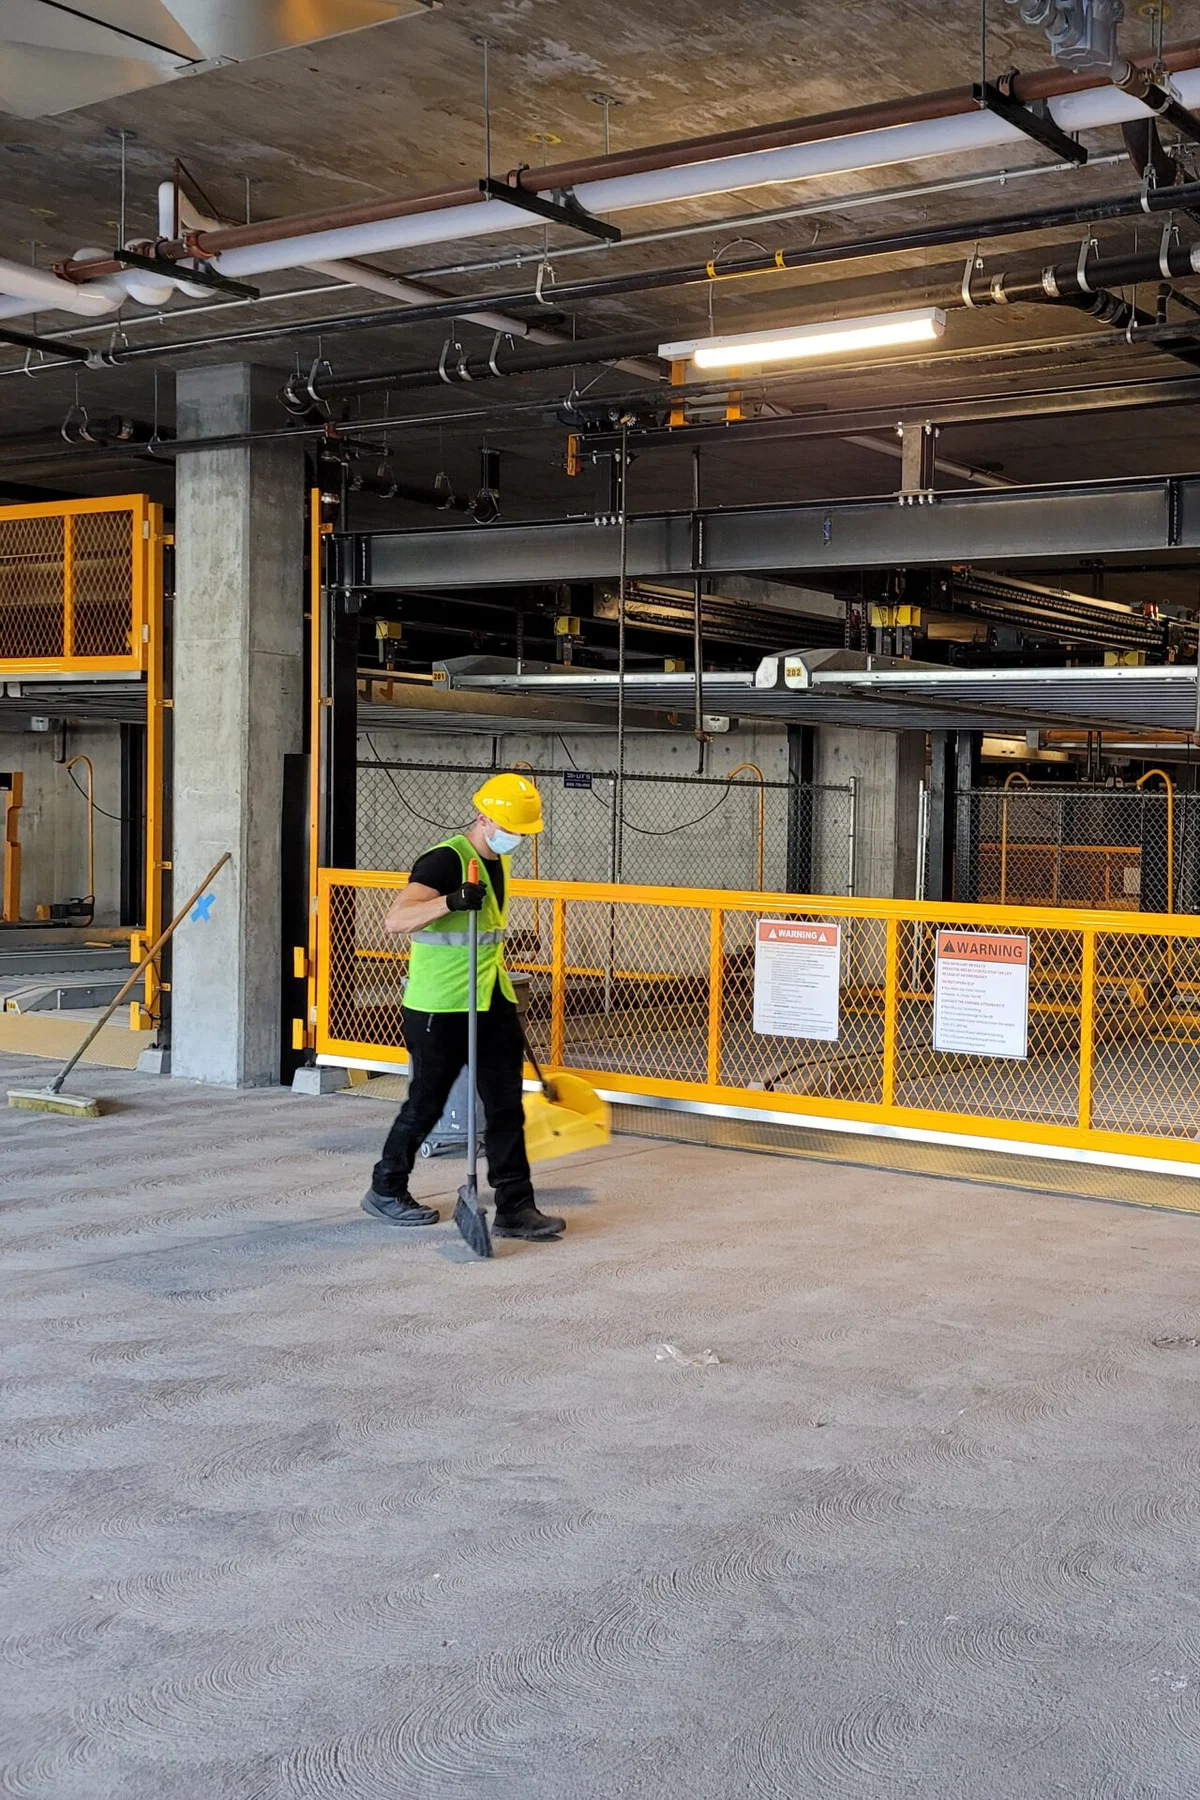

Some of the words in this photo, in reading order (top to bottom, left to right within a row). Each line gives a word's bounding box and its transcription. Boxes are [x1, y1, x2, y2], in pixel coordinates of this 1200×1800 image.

[787, 668, 801, 677] 202
[778, 929, 818, 940] WARNING
[957, 941, 1022, 958] WARNING
